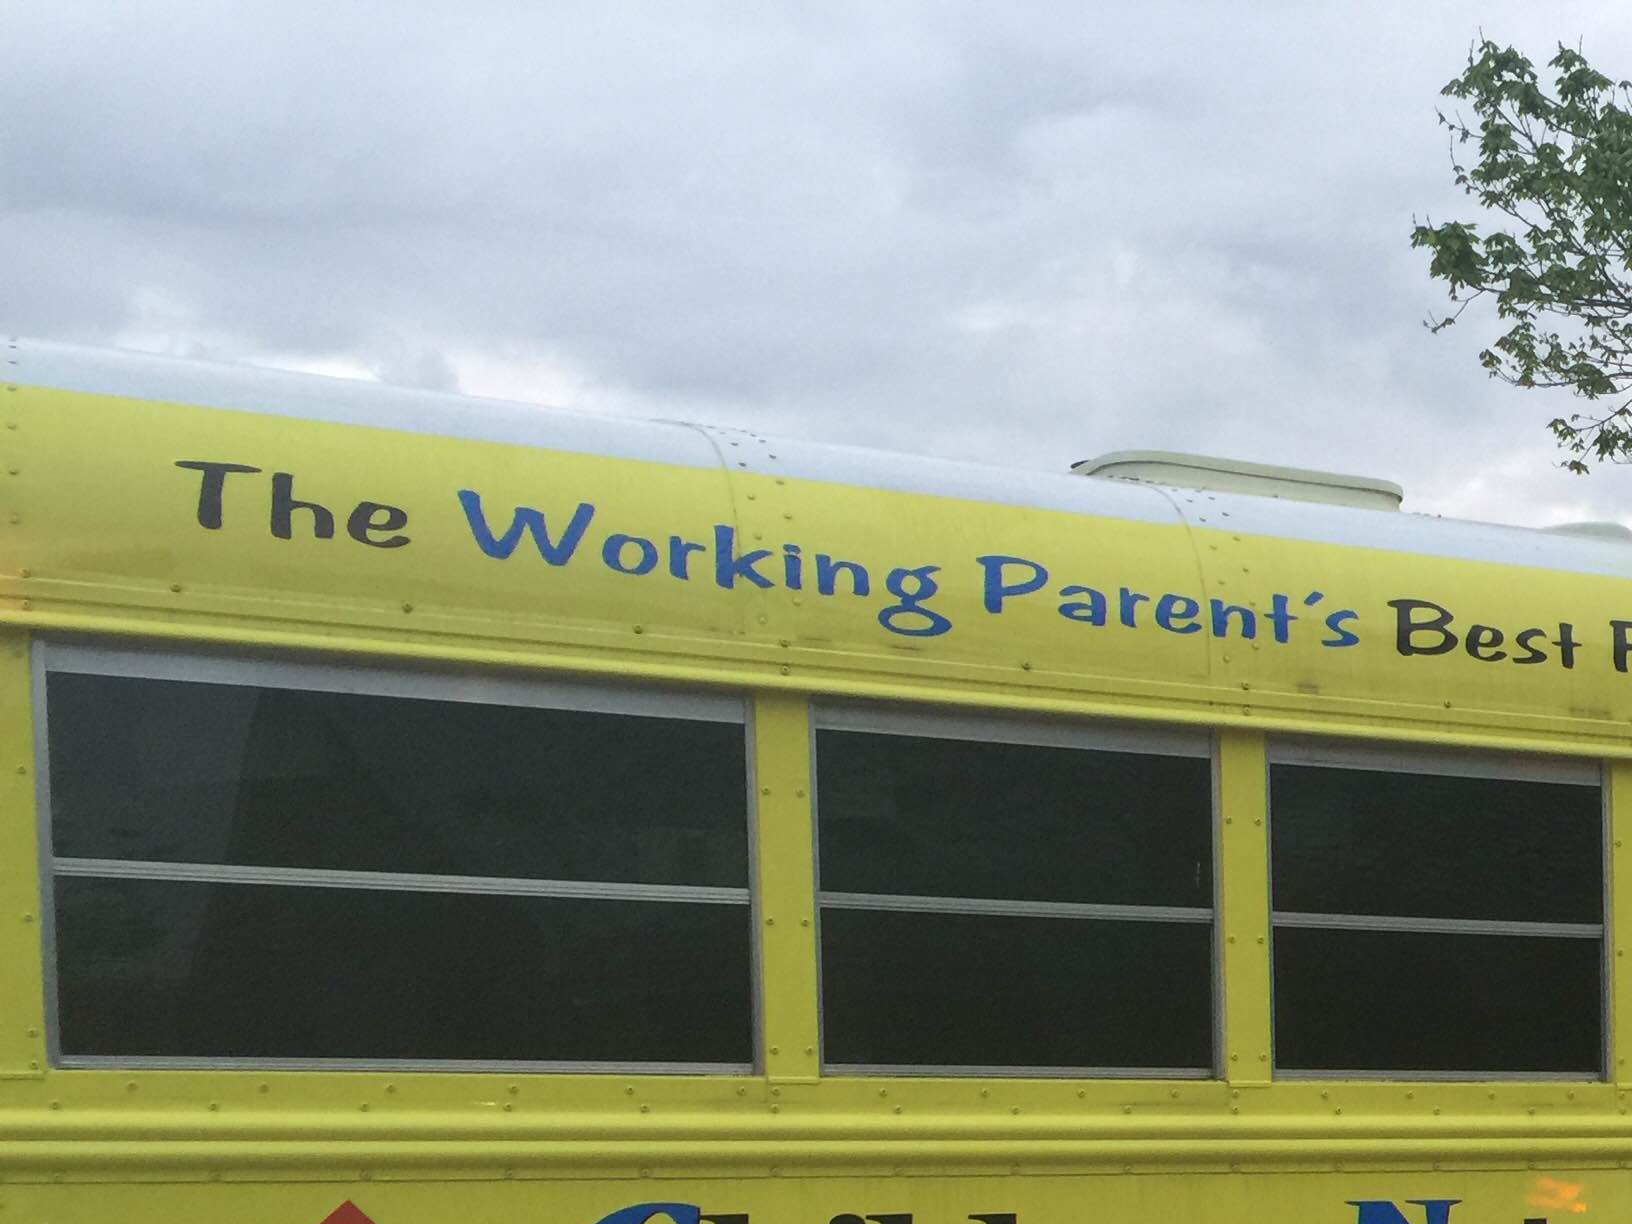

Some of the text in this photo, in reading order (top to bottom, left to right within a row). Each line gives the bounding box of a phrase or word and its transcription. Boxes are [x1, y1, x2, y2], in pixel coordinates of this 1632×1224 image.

[174, 459, 412, 550] The
[456, 489, 955, 638] Working
[975, 554, 1361, 650] Parent's
[1389, 597, 1584, 670] Best
